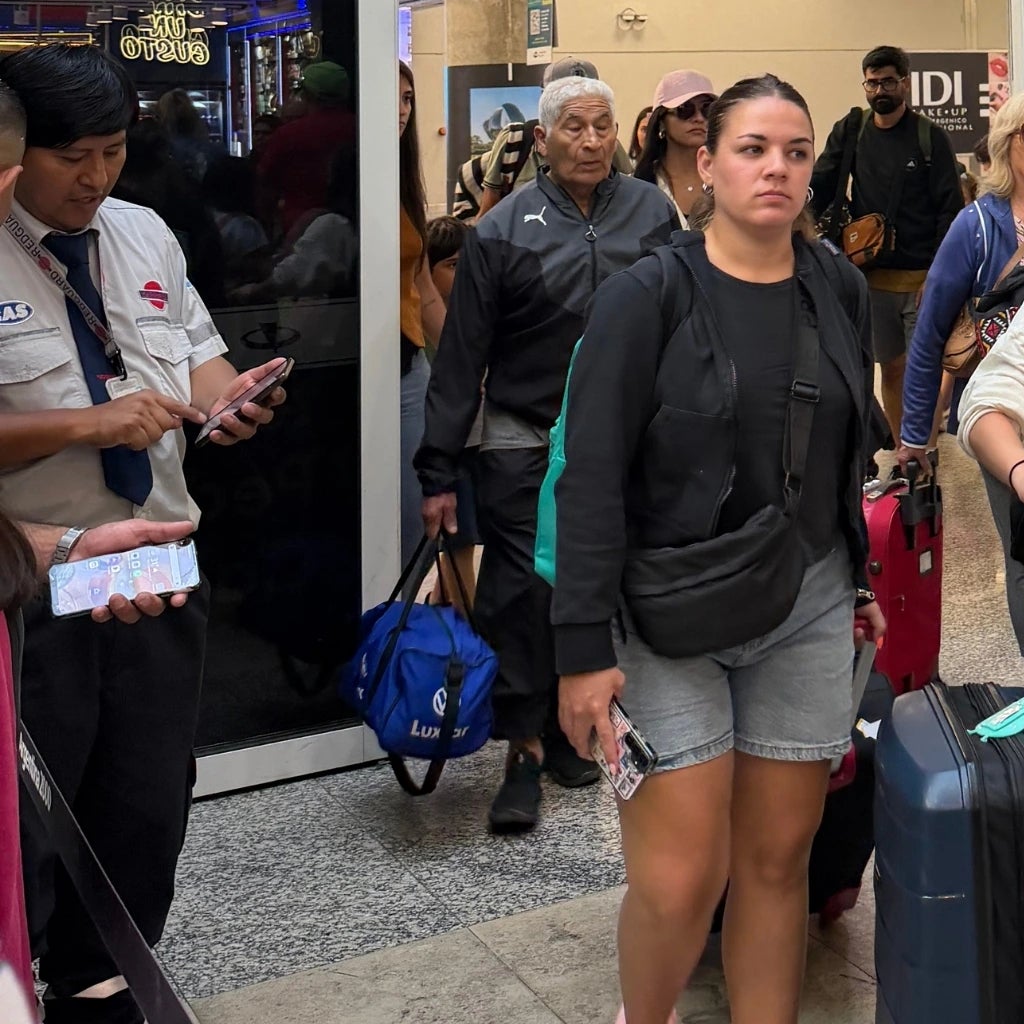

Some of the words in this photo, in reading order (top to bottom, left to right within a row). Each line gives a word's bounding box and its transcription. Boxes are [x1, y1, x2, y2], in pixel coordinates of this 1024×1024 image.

[911, 71, 963, 106] IDI
[0, 303, 29, 321] AS
[410, 719, 470, 739] Luxar
